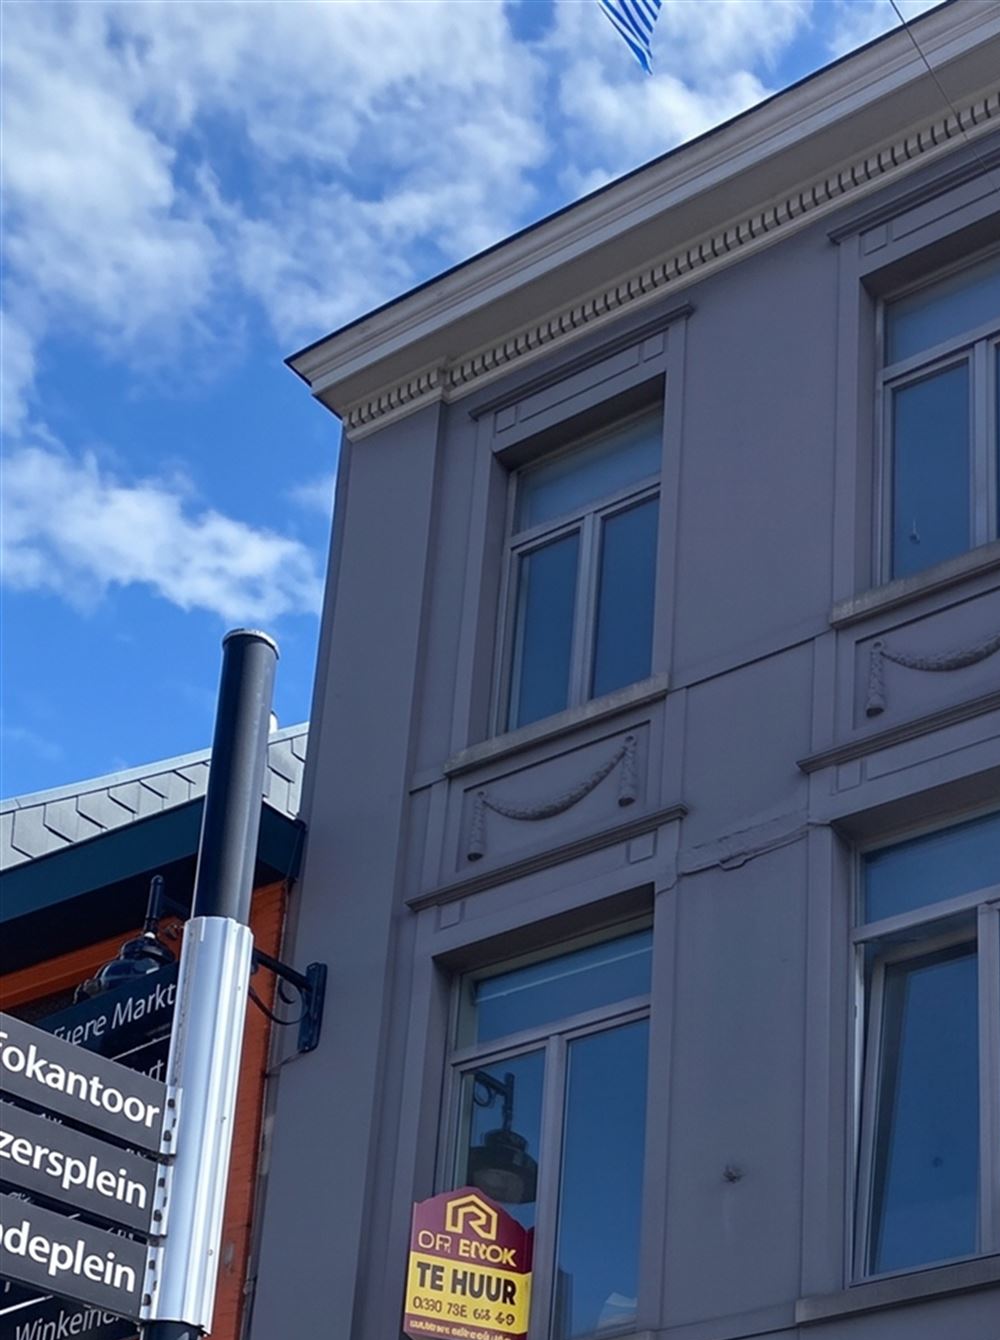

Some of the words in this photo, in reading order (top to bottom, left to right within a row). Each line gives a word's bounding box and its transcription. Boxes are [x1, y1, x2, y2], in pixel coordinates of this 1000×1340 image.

[111, 983, 176, 1030] Markt
[0, 1220, 136, 1293] deplein
[416, 1260, 445, 1292] TE
[451, 1268, 517, 1305] HUUR
